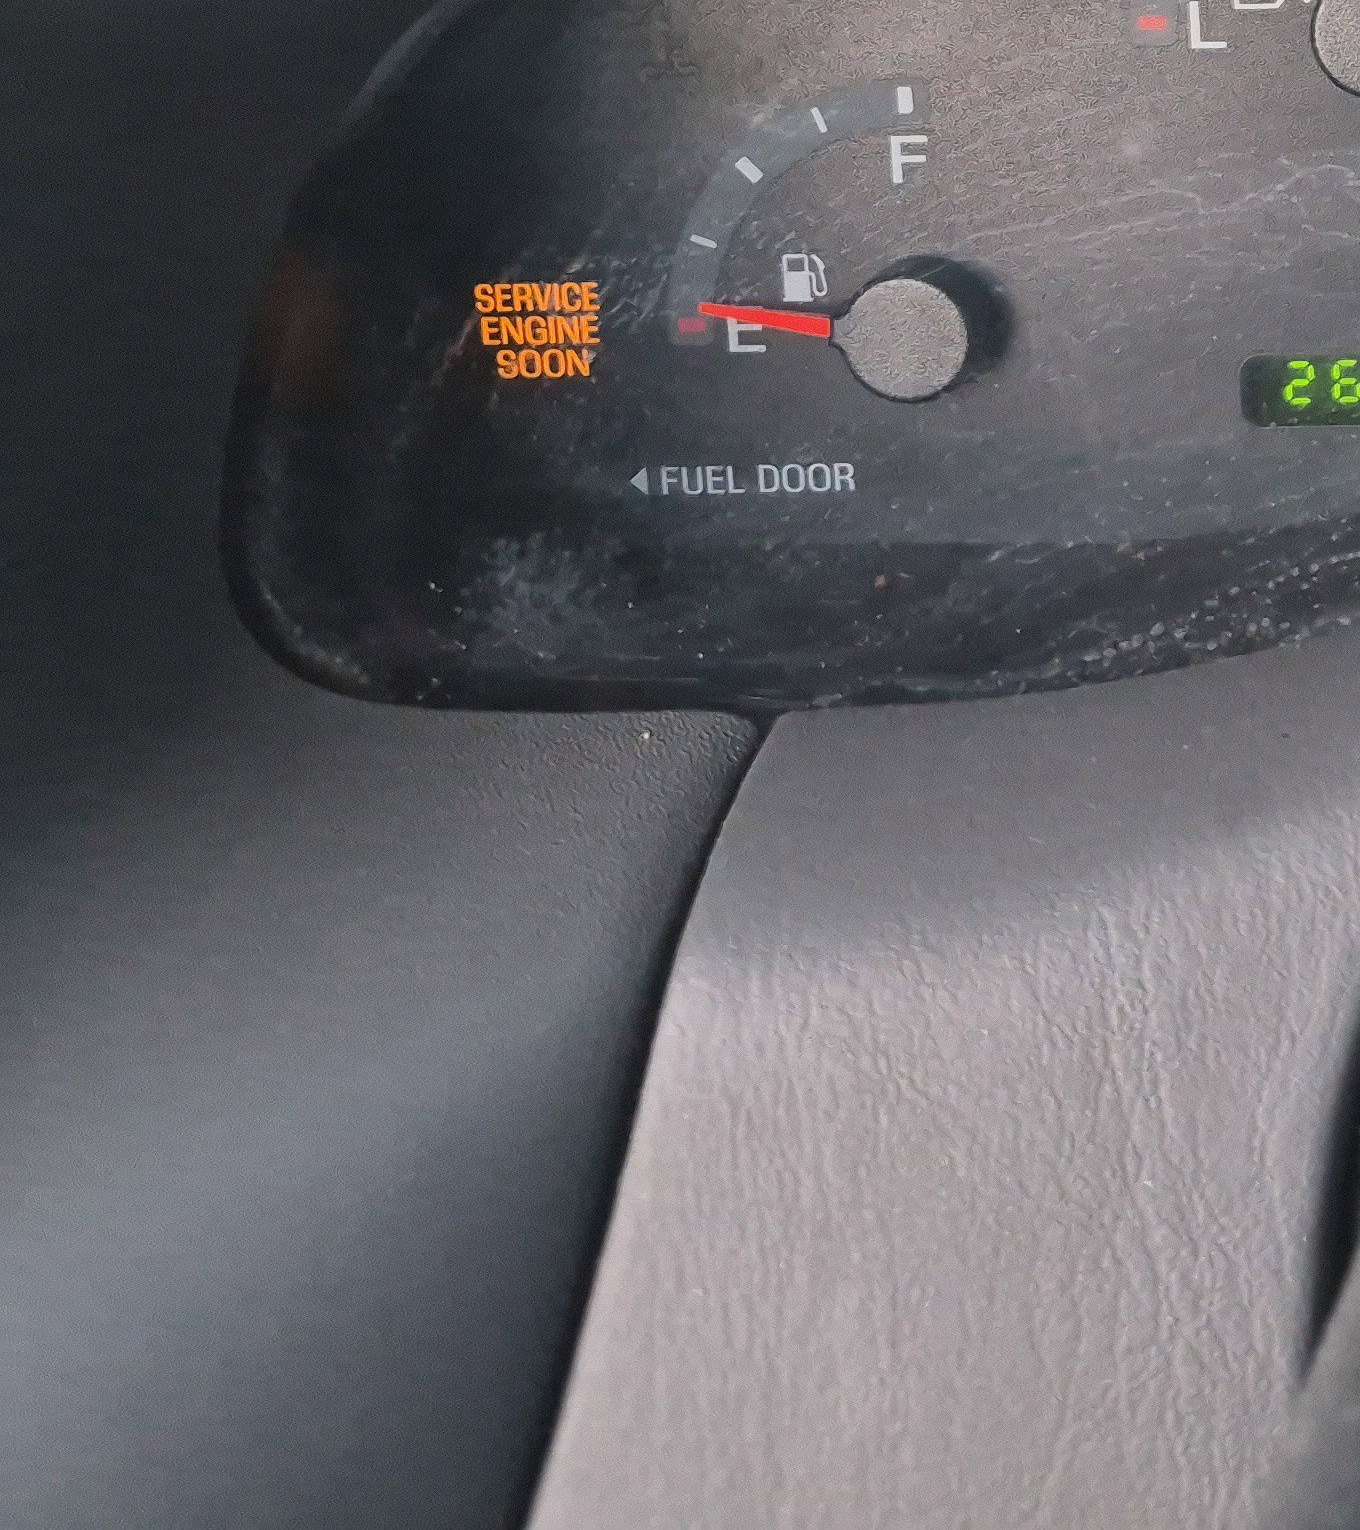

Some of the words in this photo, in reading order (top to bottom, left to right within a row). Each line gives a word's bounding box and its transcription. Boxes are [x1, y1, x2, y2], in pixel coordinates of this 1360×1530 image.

[1189, 0, 1228, 49] L
[889, 134, 929, 183] F
[473, 282, 601, 314] SERVICE
[480, 316, 601, 347] ENGINE
[495, 348, 591, 379] SOON
[661, 464, 745, 496] FUEL
[757, 462, 857, 494] DOOR
